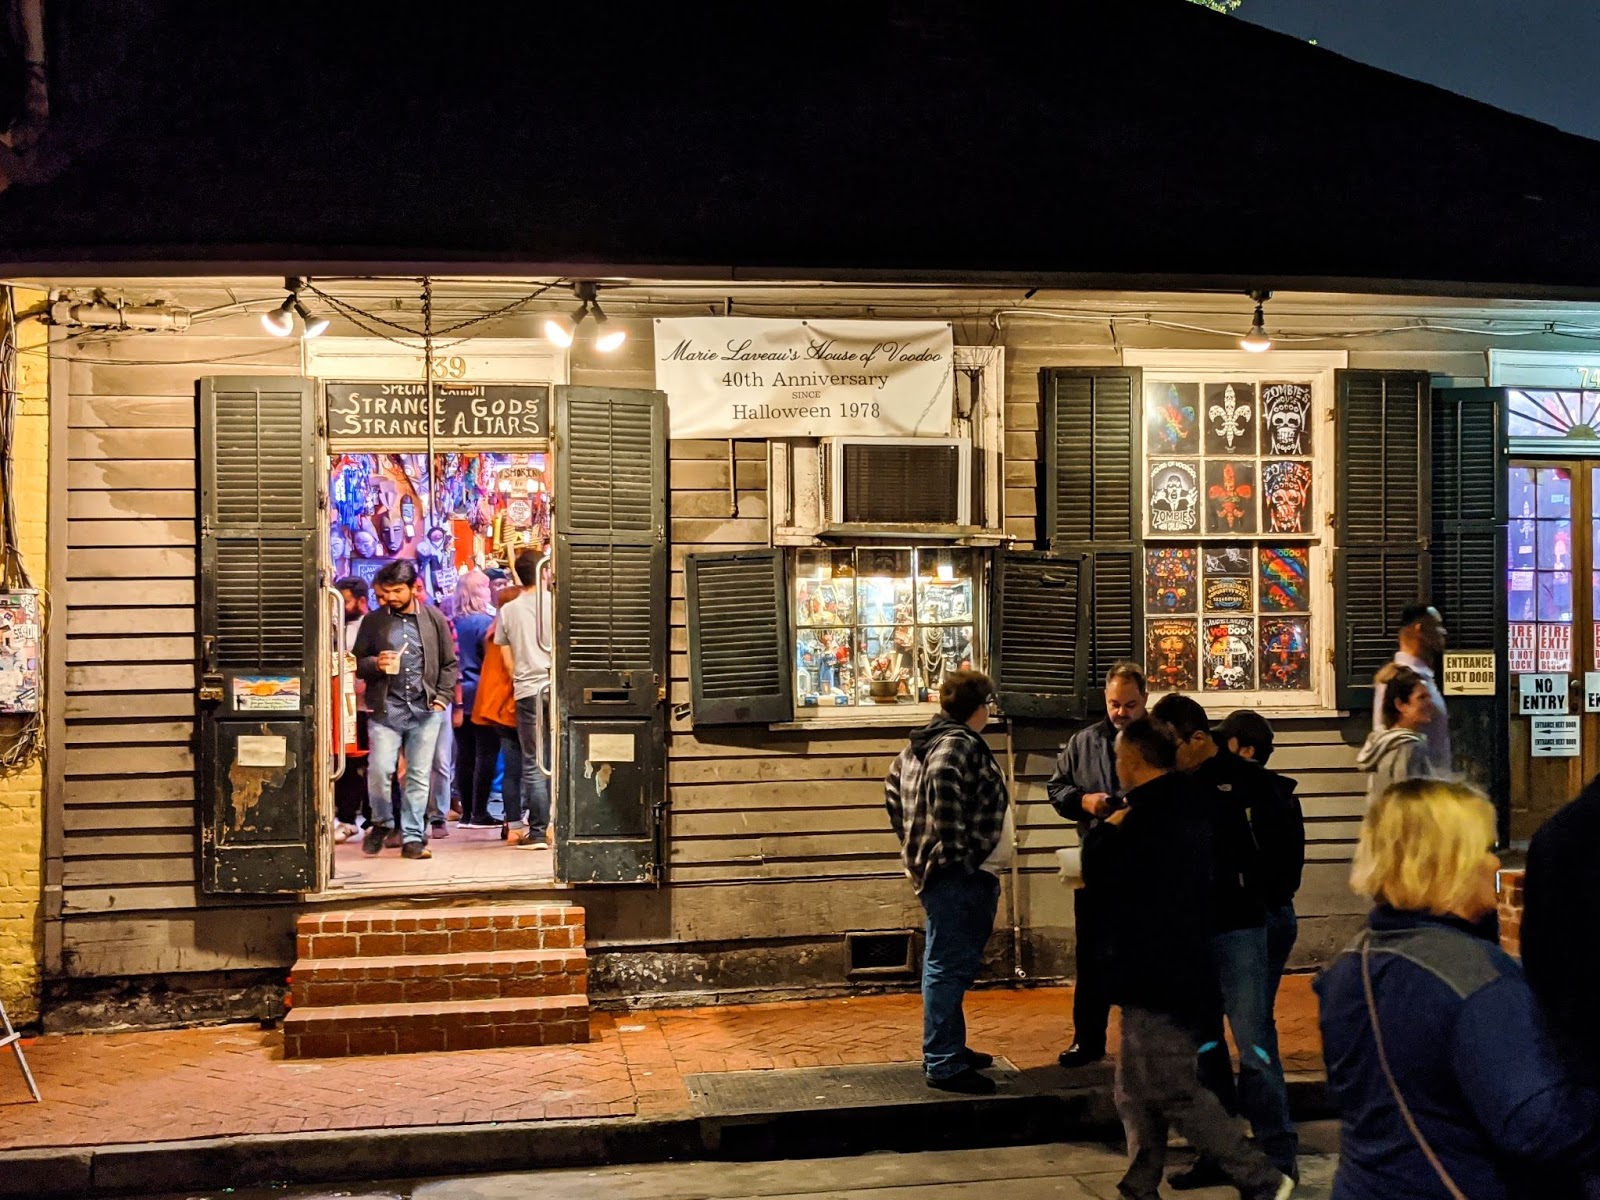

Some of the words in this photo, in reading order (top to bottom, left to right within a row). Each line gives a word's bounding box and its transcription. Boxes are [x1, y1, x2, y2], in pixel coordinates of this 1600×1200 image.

[662, 339, 718, 361] Marie
[721, 339, 800, 361] Laveau's
[804, 339, 857, 361] House
[860, 343, 875, 368] of
[882, 341, 942, 362] Voodoo
[416, 356, 466, 379] 739
[722, 372, 763, 387] 40th
[772, 371, 889, 390] Anniversary
[381, 385, 427, 395] SPECIA
[792, 391, 821, 399] SINCE
[331, 393, 446, 415] STRANGE
[471, 398, 540, 417] GODS
[732, 404, 831, 420] Halloween
[840, 402, 880, 419] 1978
[332, 414, 446, 435] STRANGE
[452, 412, 540, 435] ALTARS
[1209, 627, 1247, 636] VOODOO
[1508, 626, 1532, 637] IRE
[1541, 626, 1569, 638] FIRE
[1508, 637, 1532, 648] XIT
[1541, 638, 1568, 649] EXIT
[1517, 651, 1533, 660] NOT
[1540, 651, 1550, 660] DO
[1553, 651, 1569, 660] NOT
[1446, 657, 1493, 669] ENTRANCE
[1510, 661, 1532, 669] LOCK
[1445, 672, 1467, 683] NEXT
[1469, 671, 1494, 683] DOOR
[1535, 678, 1553, 693] NO
[1523, 695, 1565, 710] ENTRY
